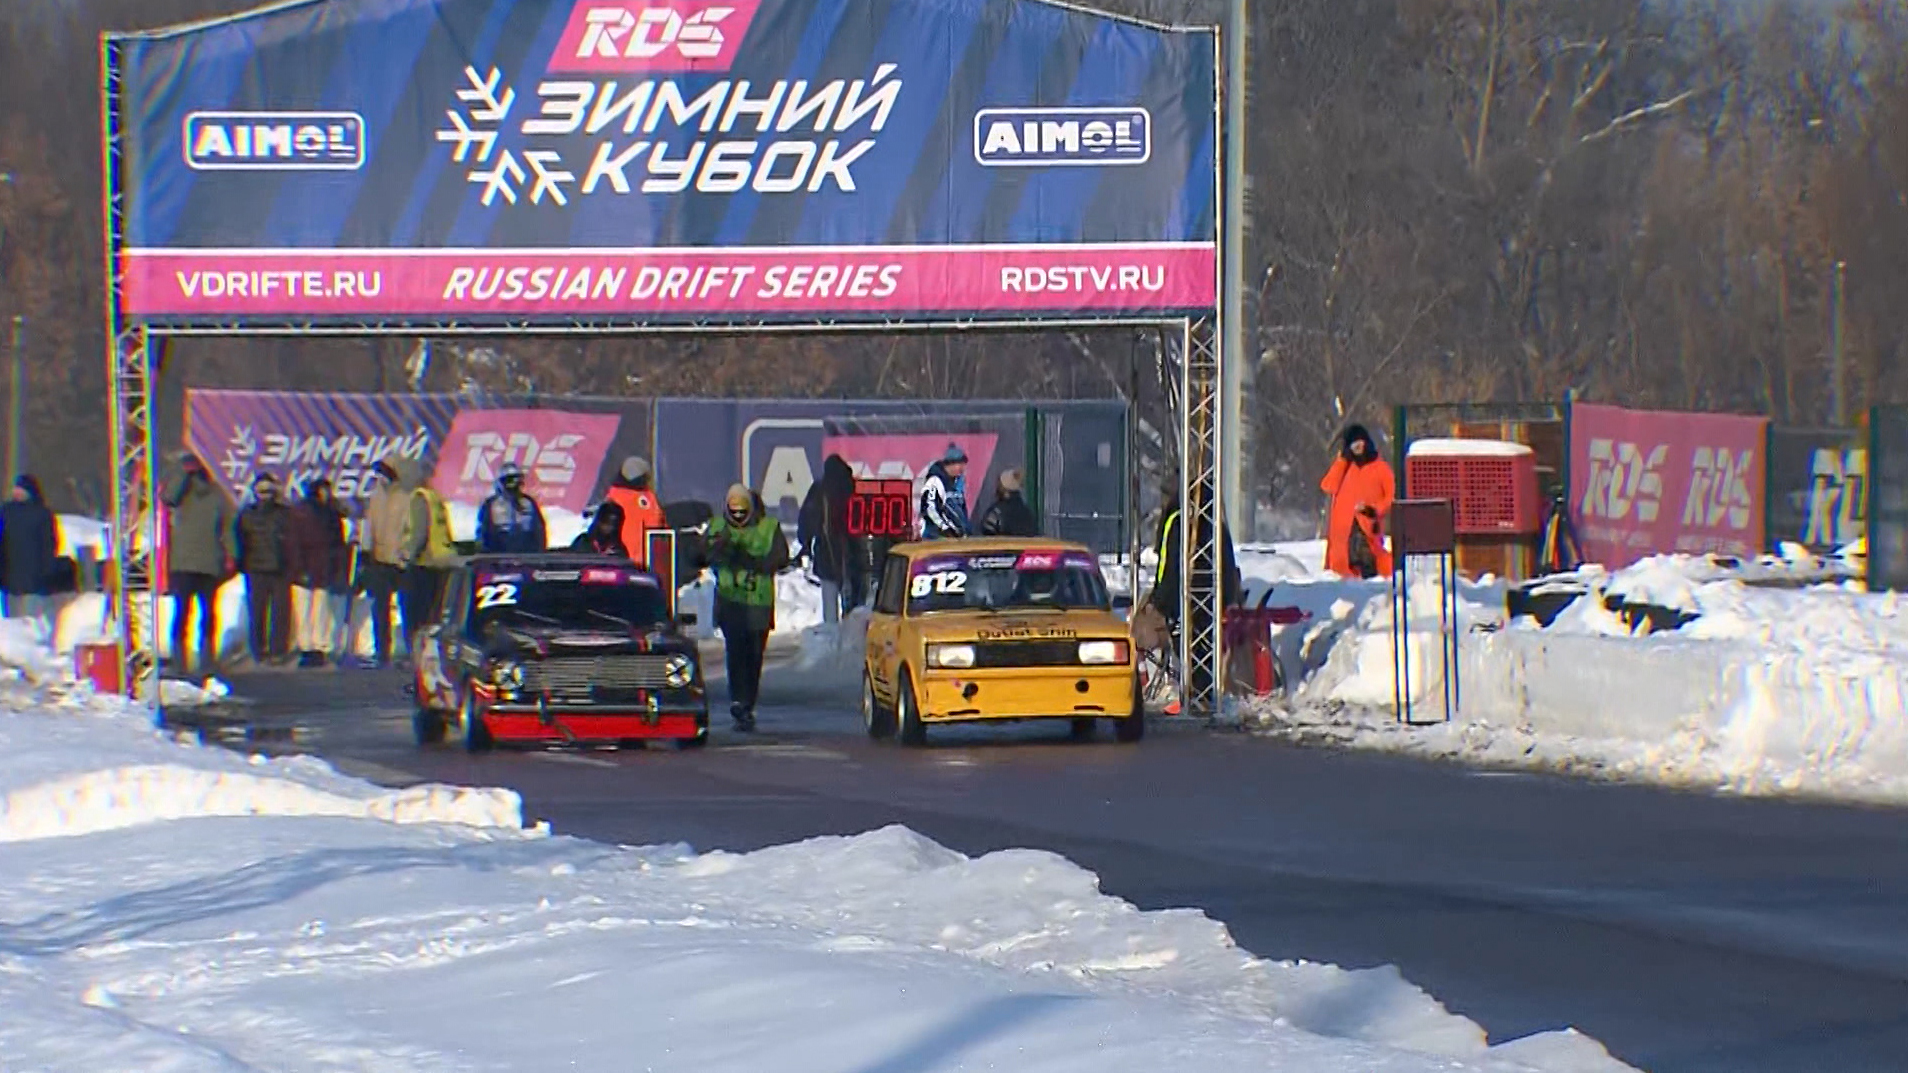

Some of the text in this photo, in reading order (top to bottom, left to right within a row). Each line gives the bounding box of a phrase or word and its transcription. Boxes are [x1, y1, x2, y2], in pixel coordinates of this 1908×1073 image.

[576, 7, 735, 58] RDS
[521, 63, 903, 134] ЗИМНИЙ
[193, 124, 358, 157] AIMOL
[982, 119, 1143, 153] AIMOL
[582, 140, 876, 194] КУБОК
[176, 271, 382, 297] VDRIFTE.RU
[443, 264, 902, 300] RUSSIAN DRIFT SERIES
[1000, 265, 1165, 292] RDSTV.RU
[258, 426, 429, 464] ЗИМНИЙ
[460, 432, 586, 482] RDS
[1803, 448, 1866, 546] RD
[476, 583, 518, 609] 22
[911, 571, 967, 598] 812
